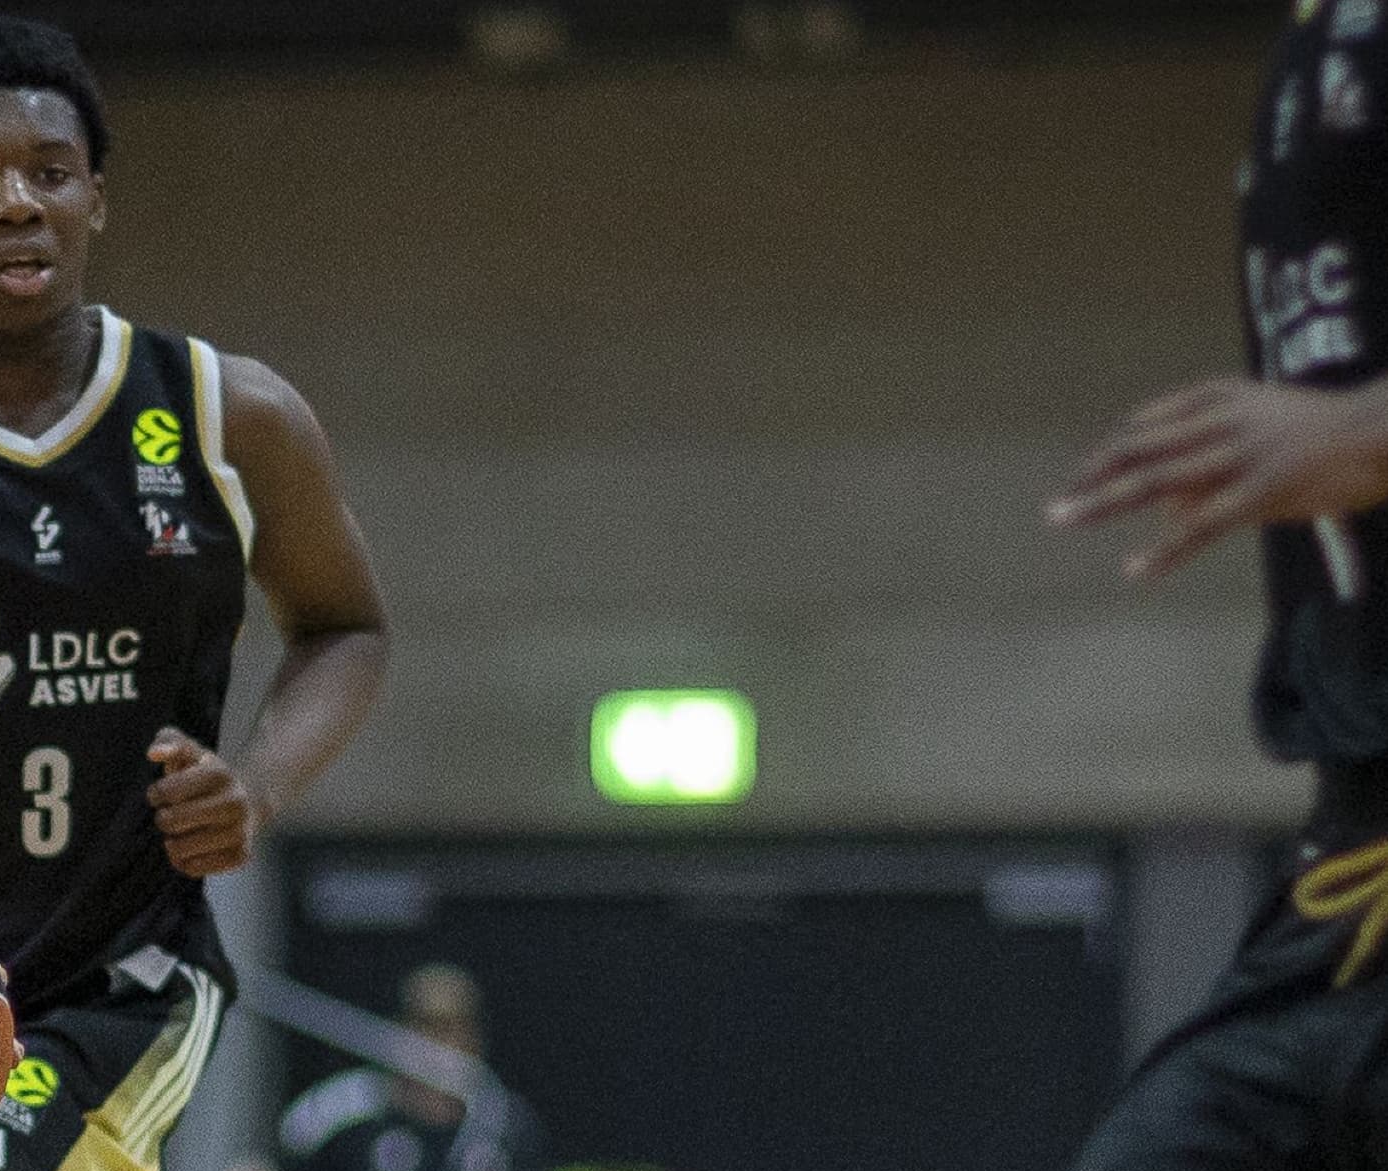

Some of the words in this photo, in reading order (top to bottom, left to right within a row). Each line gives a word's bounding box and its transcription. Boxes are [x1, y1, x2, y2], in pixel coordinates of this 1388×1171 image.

[28, 629, 141, 671] LDLC
[28, 671, 139, 706] ASVEL
[21, 747, 71, 857] 3
